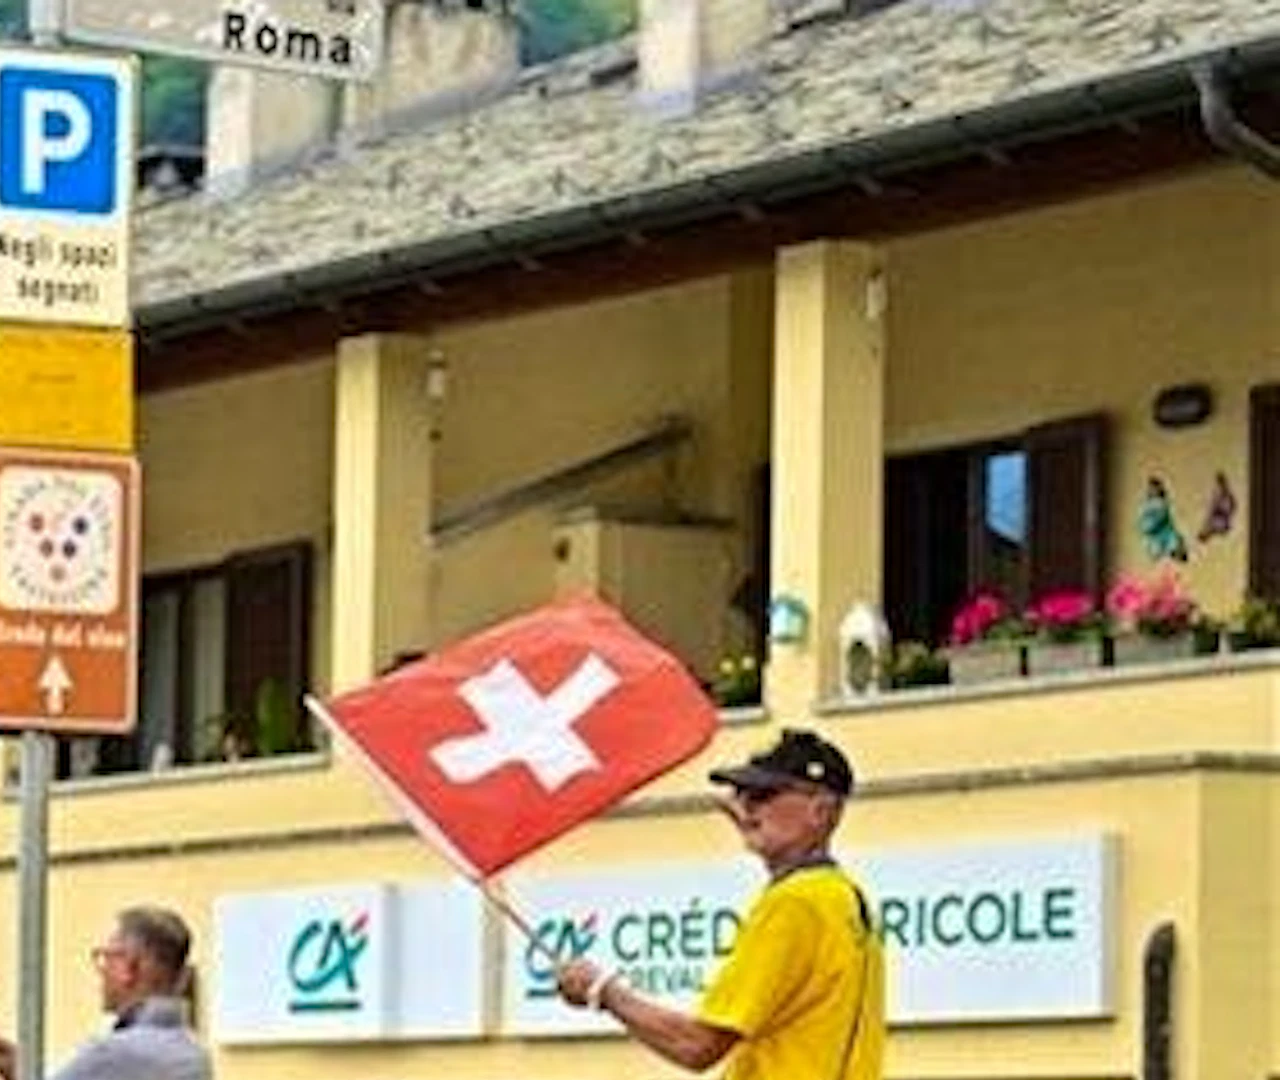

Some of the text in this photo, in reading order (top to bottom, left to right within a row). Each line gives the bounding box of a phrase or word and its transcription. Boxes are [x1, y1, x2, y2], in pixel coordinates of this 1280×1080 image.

[224, 13, 352, 65] Roma
[21, 89, 92, 194] P
[60, 241, 119, 276] spazi
[17, 276, 100, 306] segnati
[611, 898, 743, 961] CRÉD
[880, 888, 1076, 947] RICOLE
